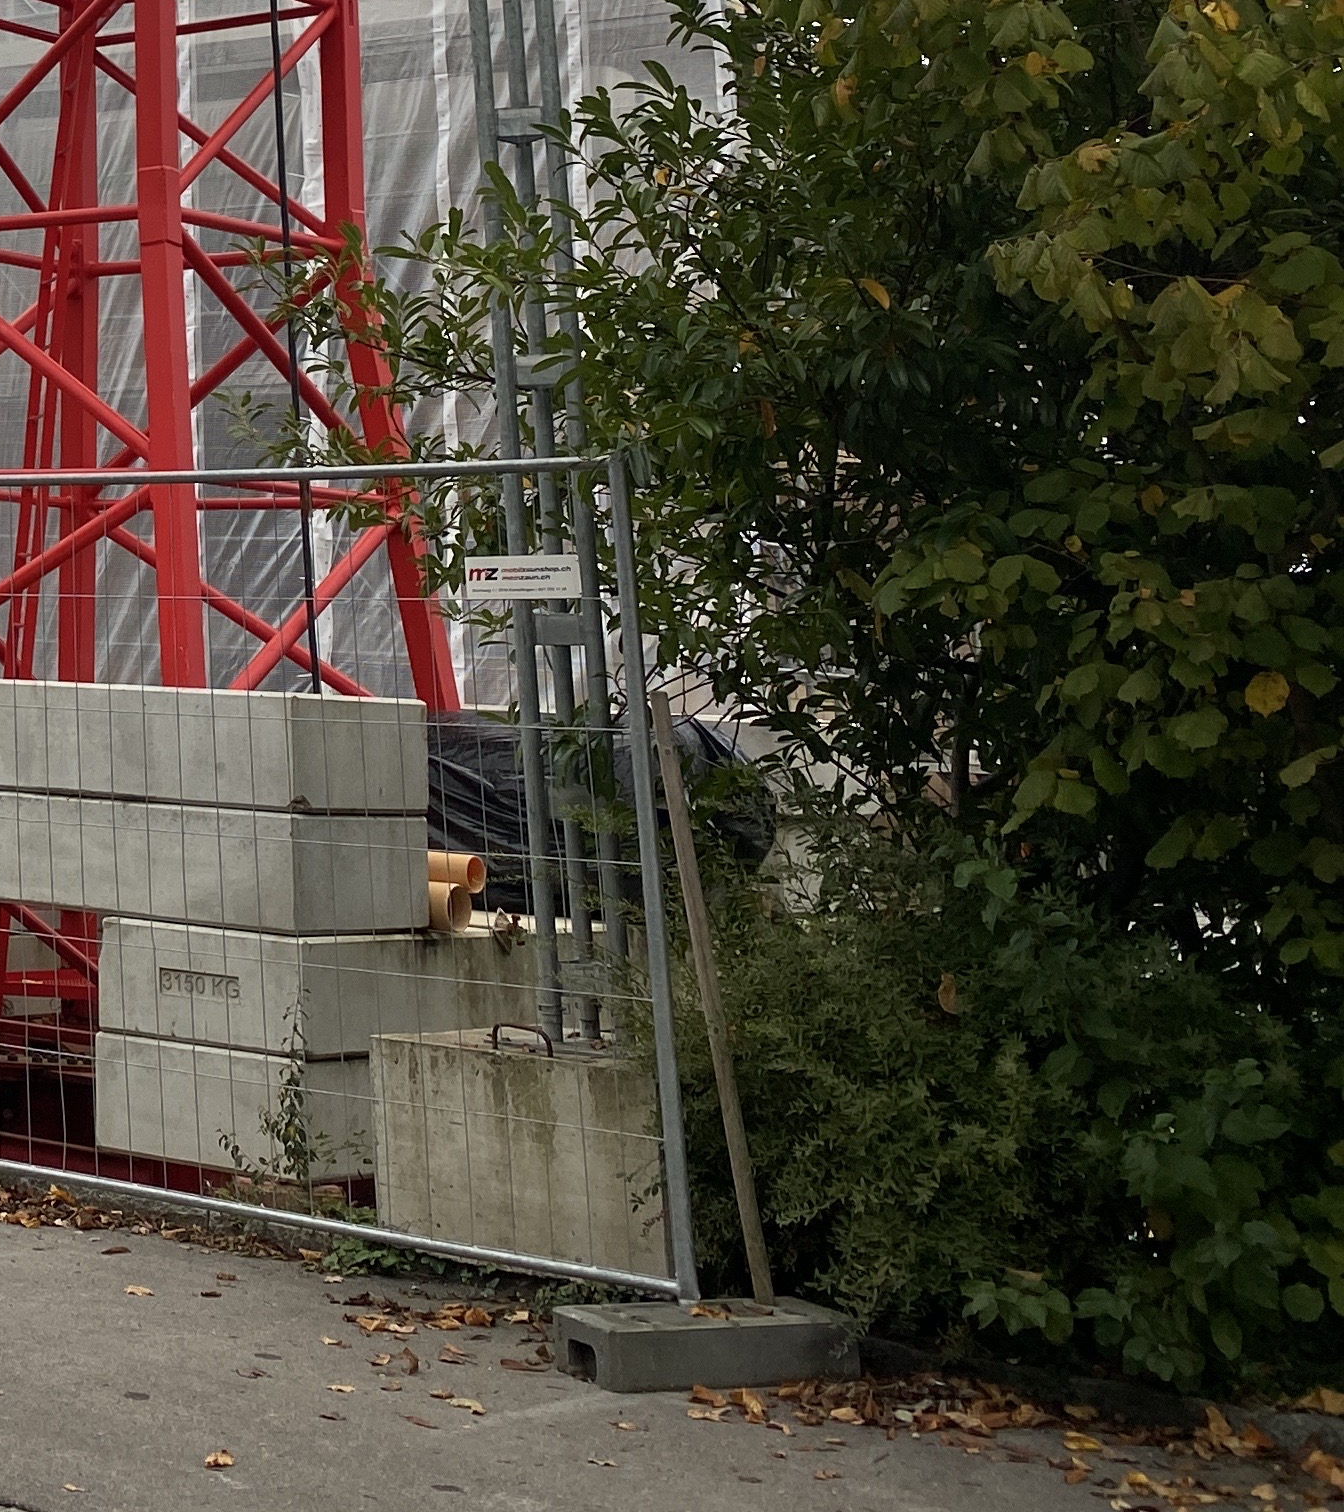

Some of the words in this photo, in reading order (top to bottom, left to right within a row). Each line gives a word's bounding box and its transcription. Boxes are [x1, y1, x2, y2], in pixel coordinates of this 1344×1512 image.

[469, 568, 498, 581] mz
[162, 972, 205, 995] 3150
[212, 978, 240, 999] KG
